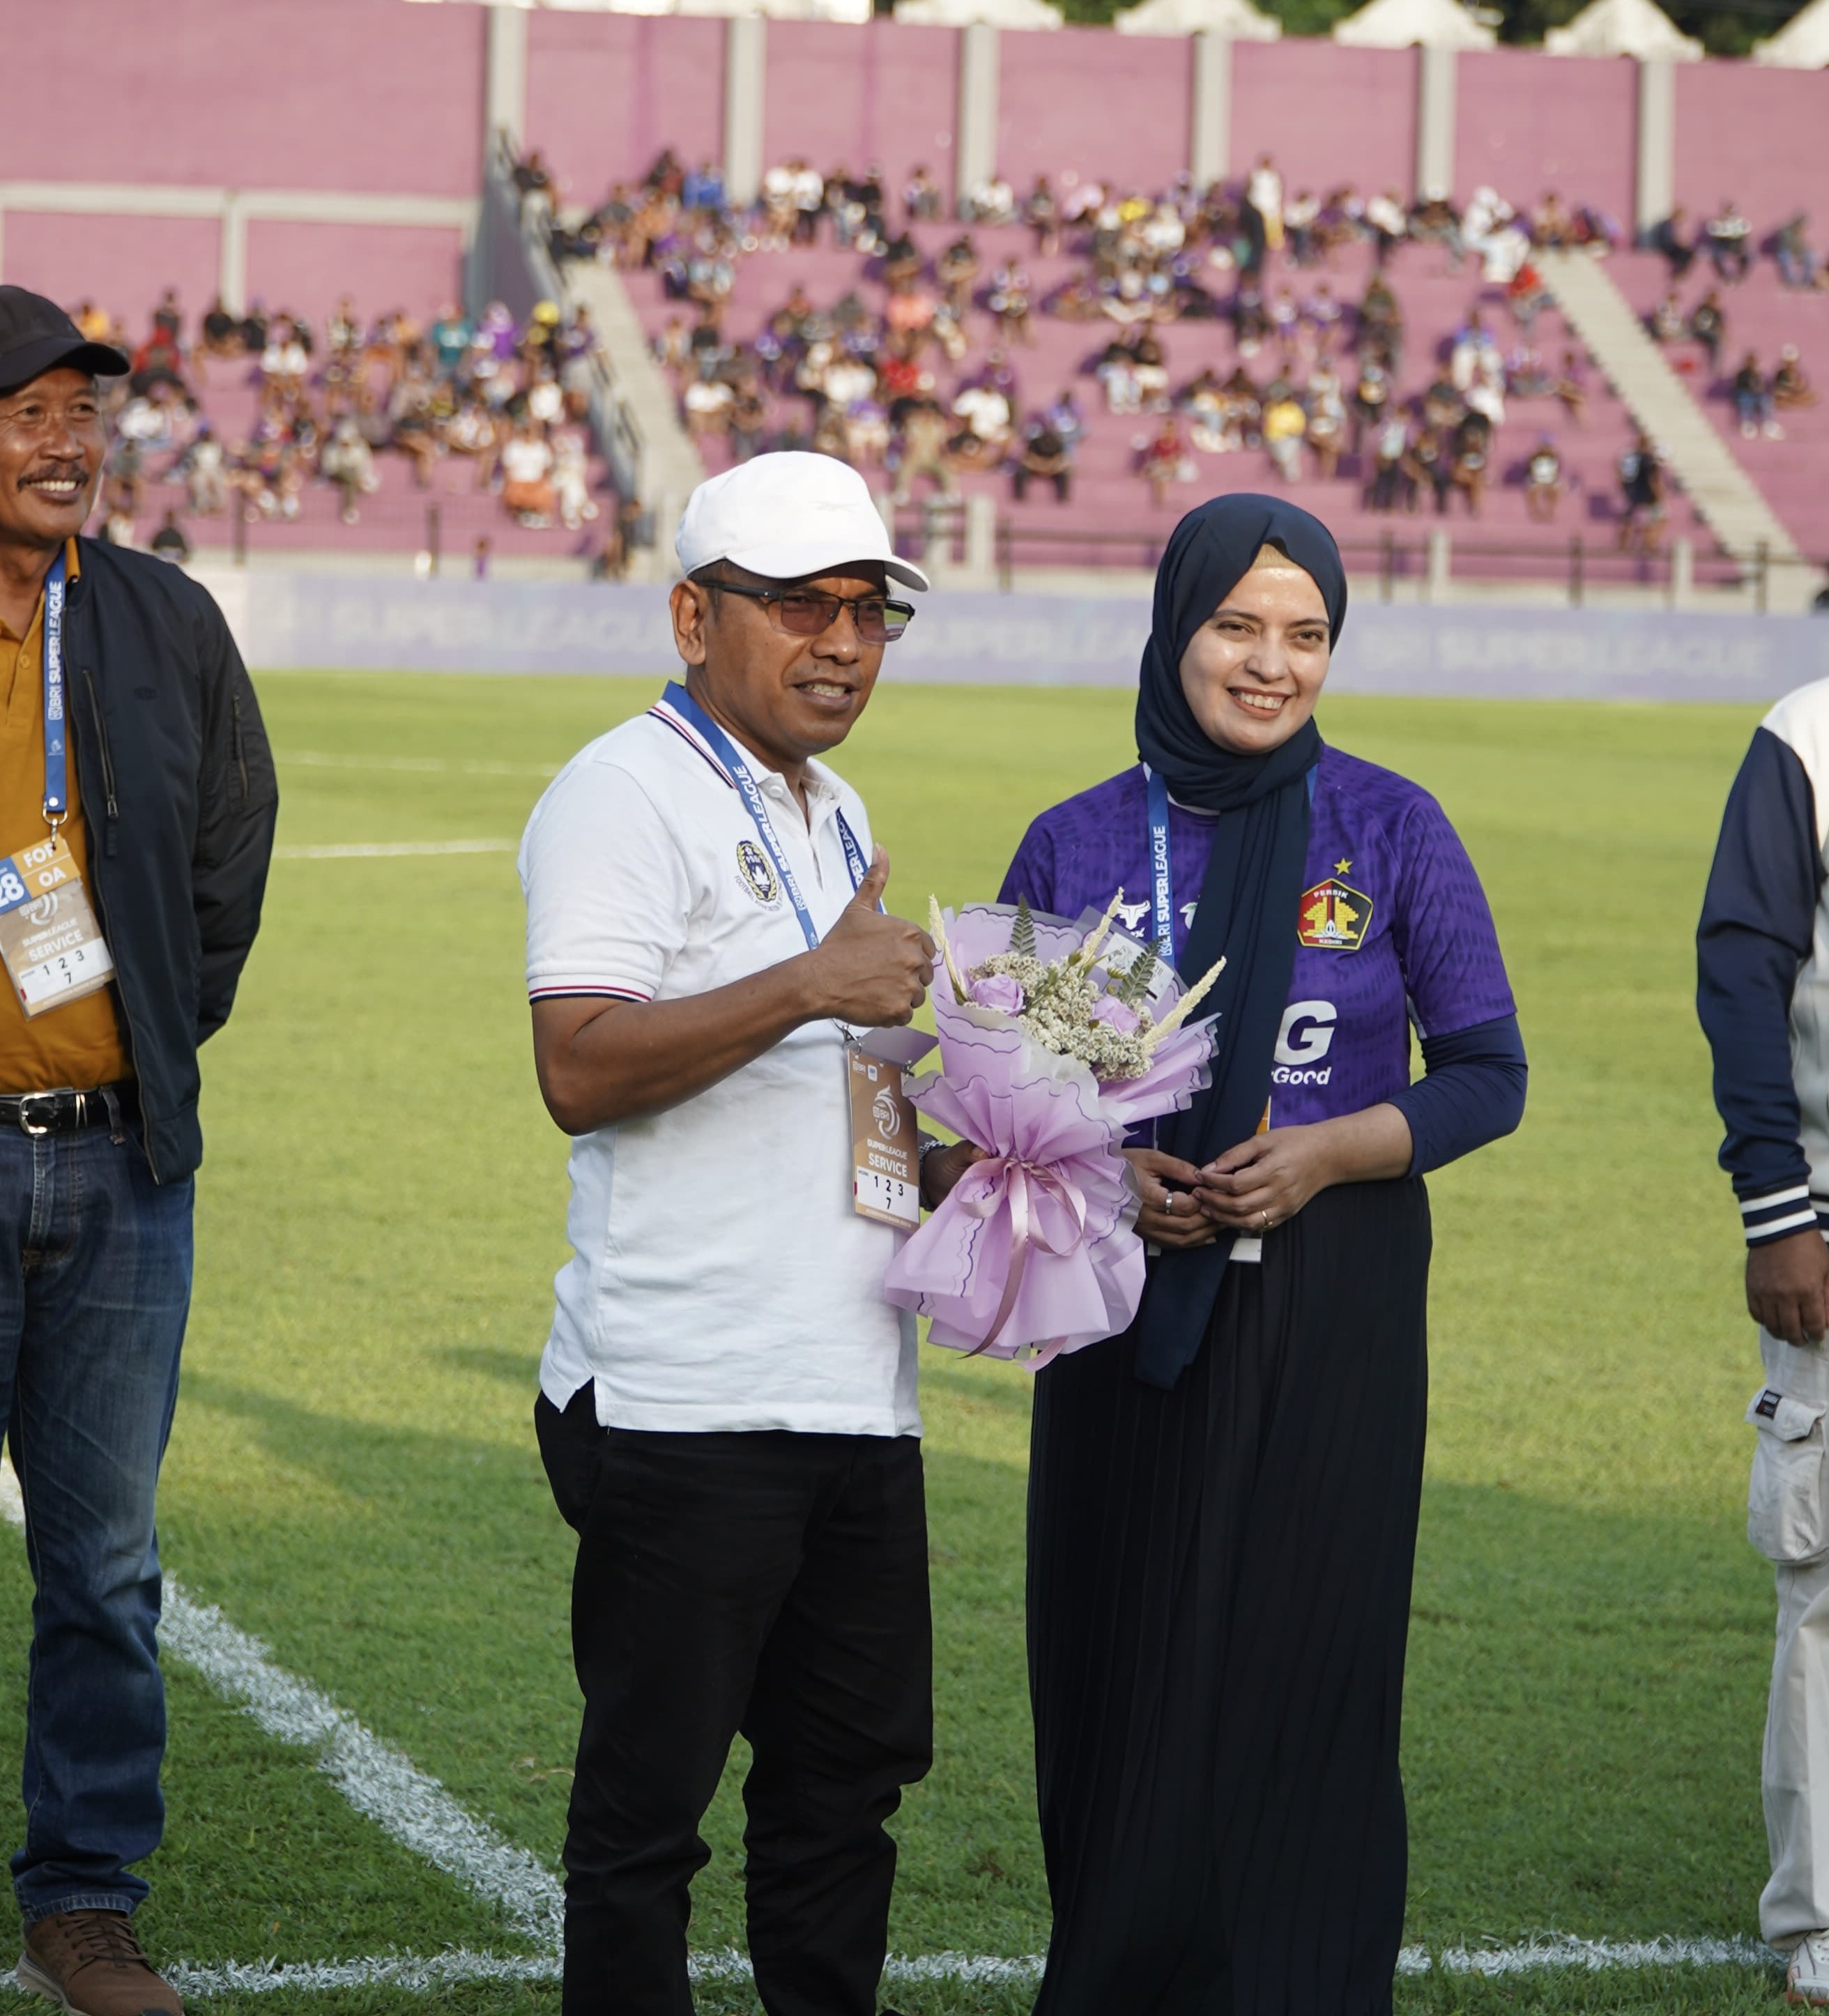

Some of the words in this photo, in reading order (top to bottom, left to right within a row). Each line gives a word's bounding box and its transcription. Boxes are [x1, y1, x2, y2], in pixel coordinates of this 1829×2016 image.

[38, 866, 66, 887] OA
[1313, 889, 1349, 899] PERSIK
[29, 929, 84, 962] SERVICE
[43, 965, 50, 976] 1
[59, 958, 68, 970] 2
[75, 950, 84, 962] 3
[65, 972, 72, 984] 7
[1271, 1066, 1332, 1085] Gord
[868, 1152, 908, 1178] SERVICE
[874, 1175, 878, 1188] 1
[886, 1179, 891, 1192] 2
[898, 1184, 904, 1196] 3
[886, 1197, 891, 1209] 7
